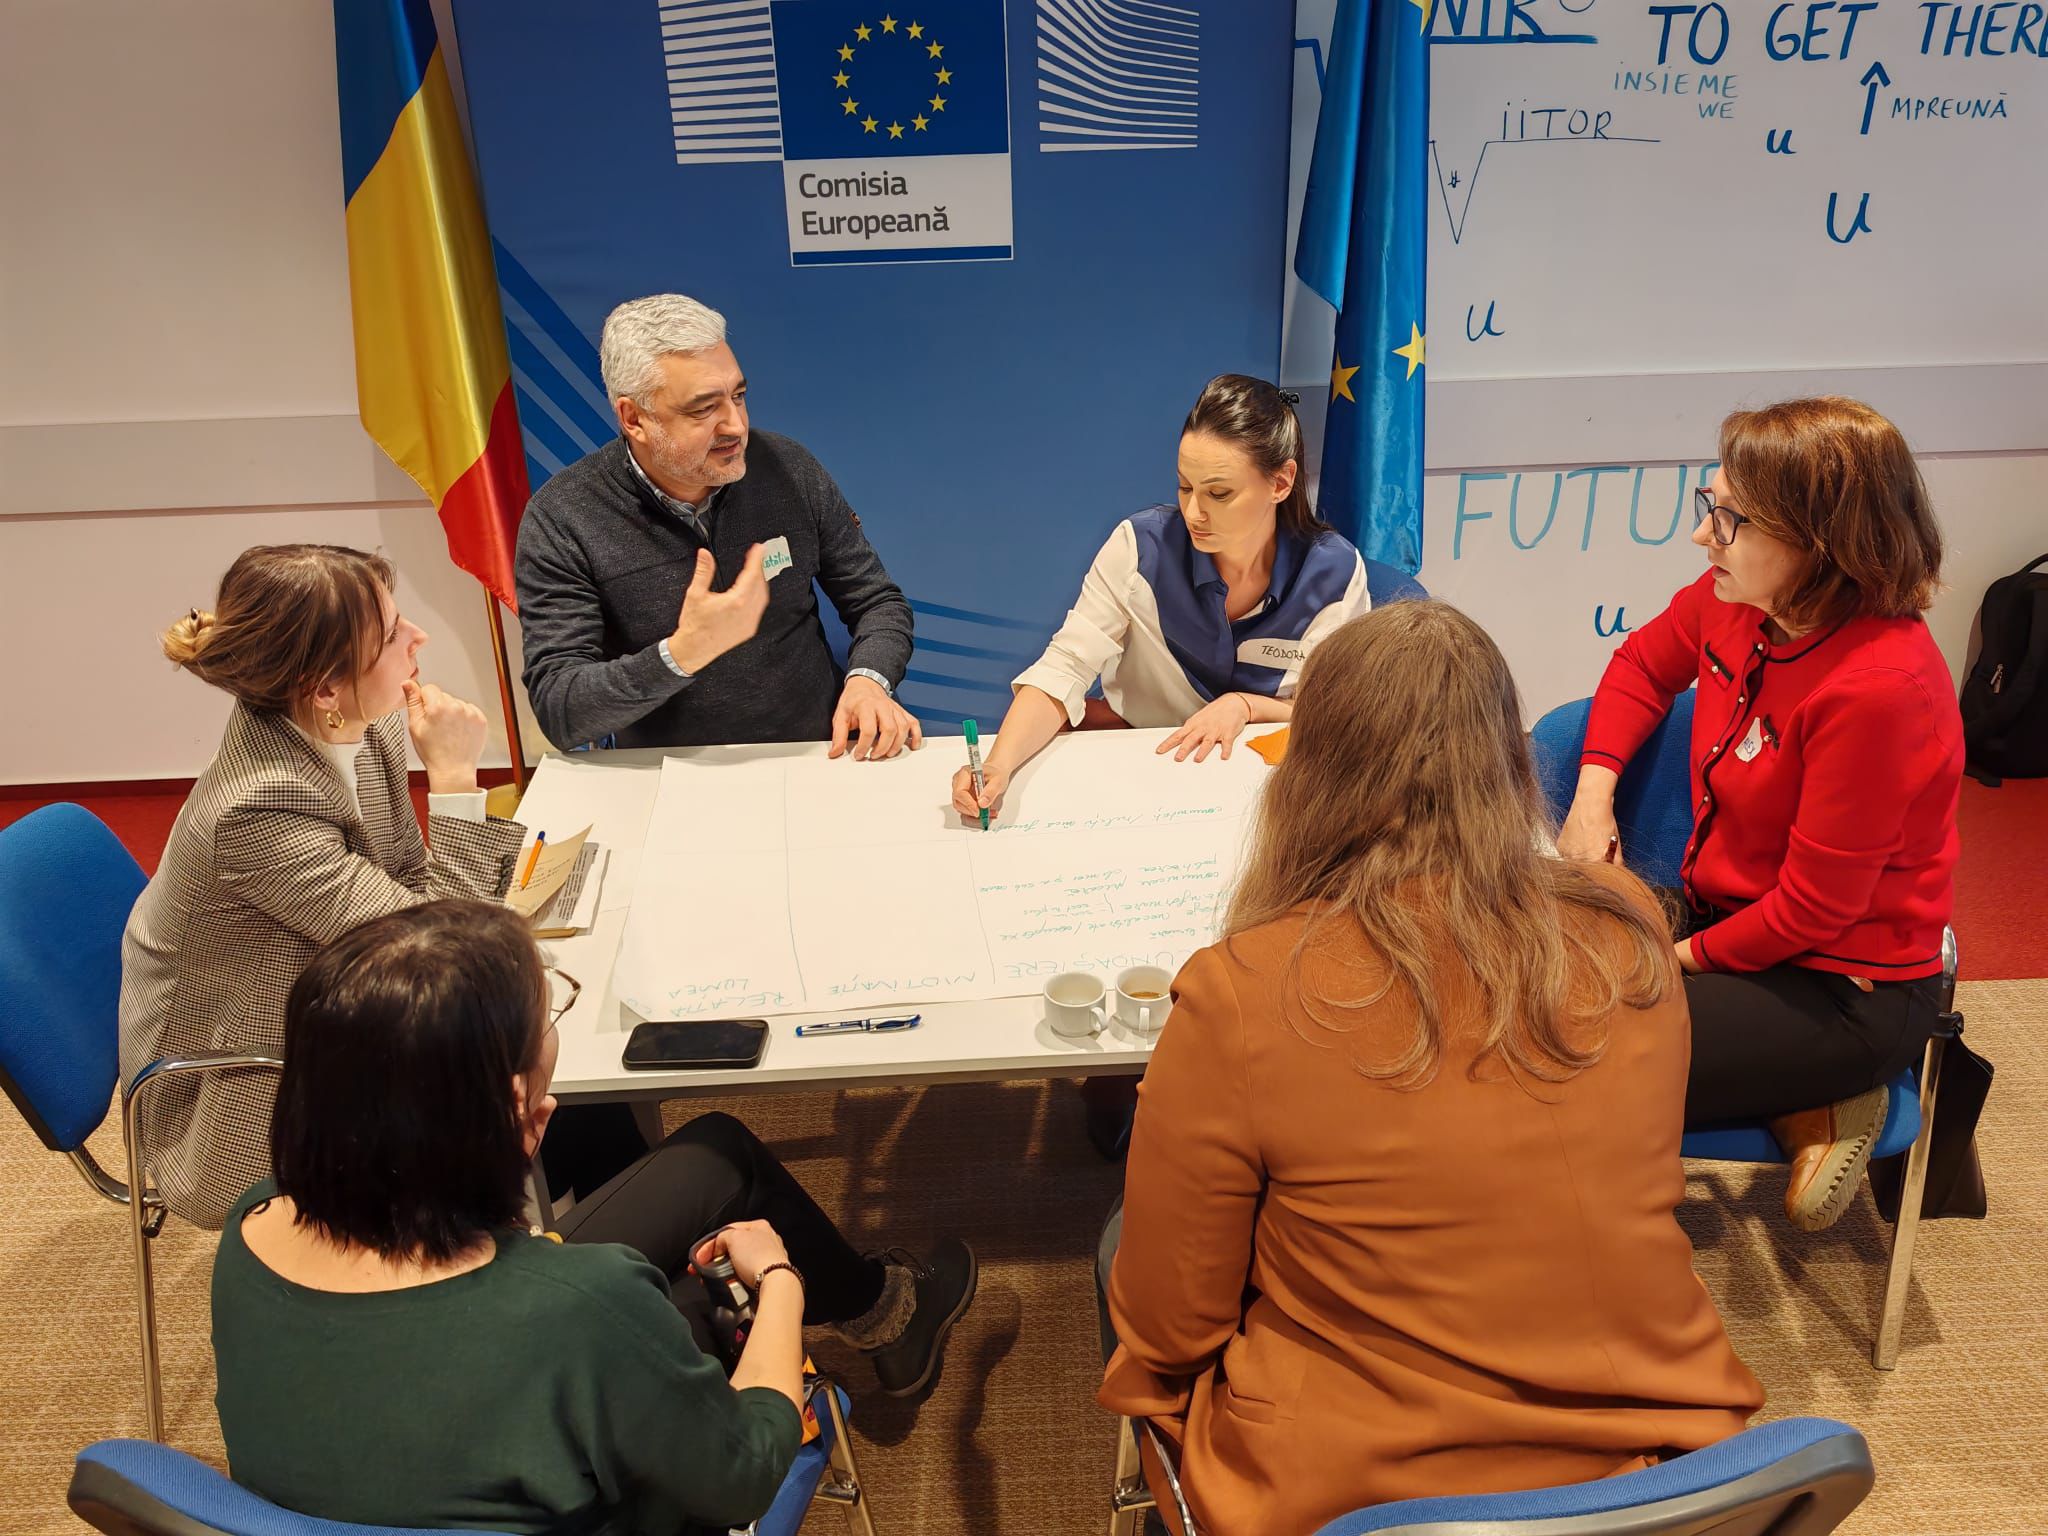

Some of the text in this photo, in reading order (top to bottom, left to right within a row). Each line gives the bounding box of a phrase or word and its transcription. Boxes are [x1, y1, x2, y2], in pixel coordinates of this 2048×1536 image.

[1648, 2, 1730, 65] TO
[1765, 1, 1879, 61] GET
[1698, 102, 1735, 119] WE
[799, 171, 908, 199] Comisia
[802, 206, 950, 241] Europeană
